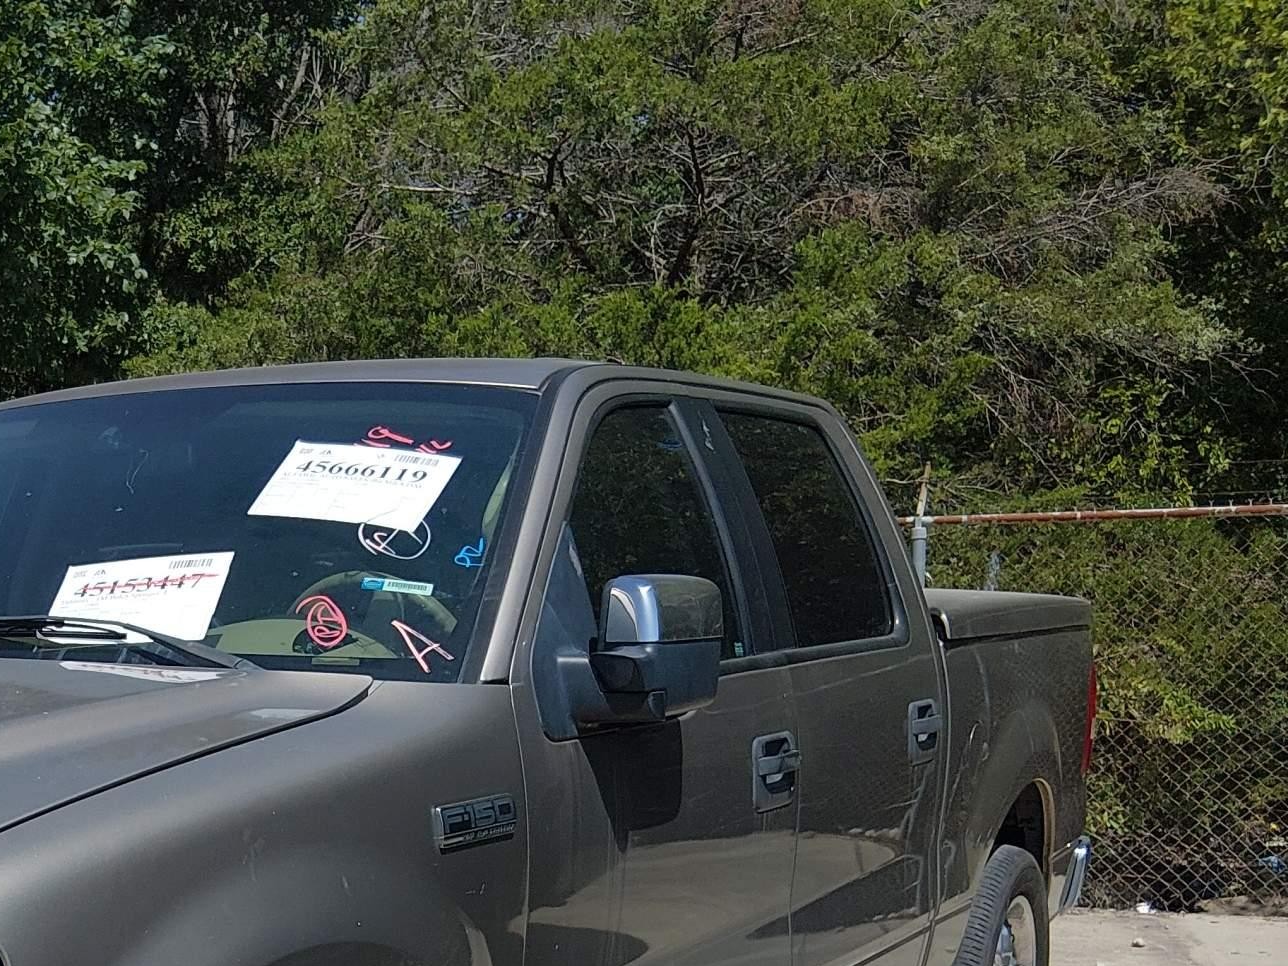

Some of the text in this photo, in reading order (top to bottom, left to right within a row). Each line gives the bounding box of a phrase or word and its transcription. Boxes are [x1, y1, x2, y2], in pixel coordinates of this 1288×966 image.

[295, 459, 428, 484] 45666119
[390, 619, 455, 674] A
[441, 798, 517, 834] F-150
